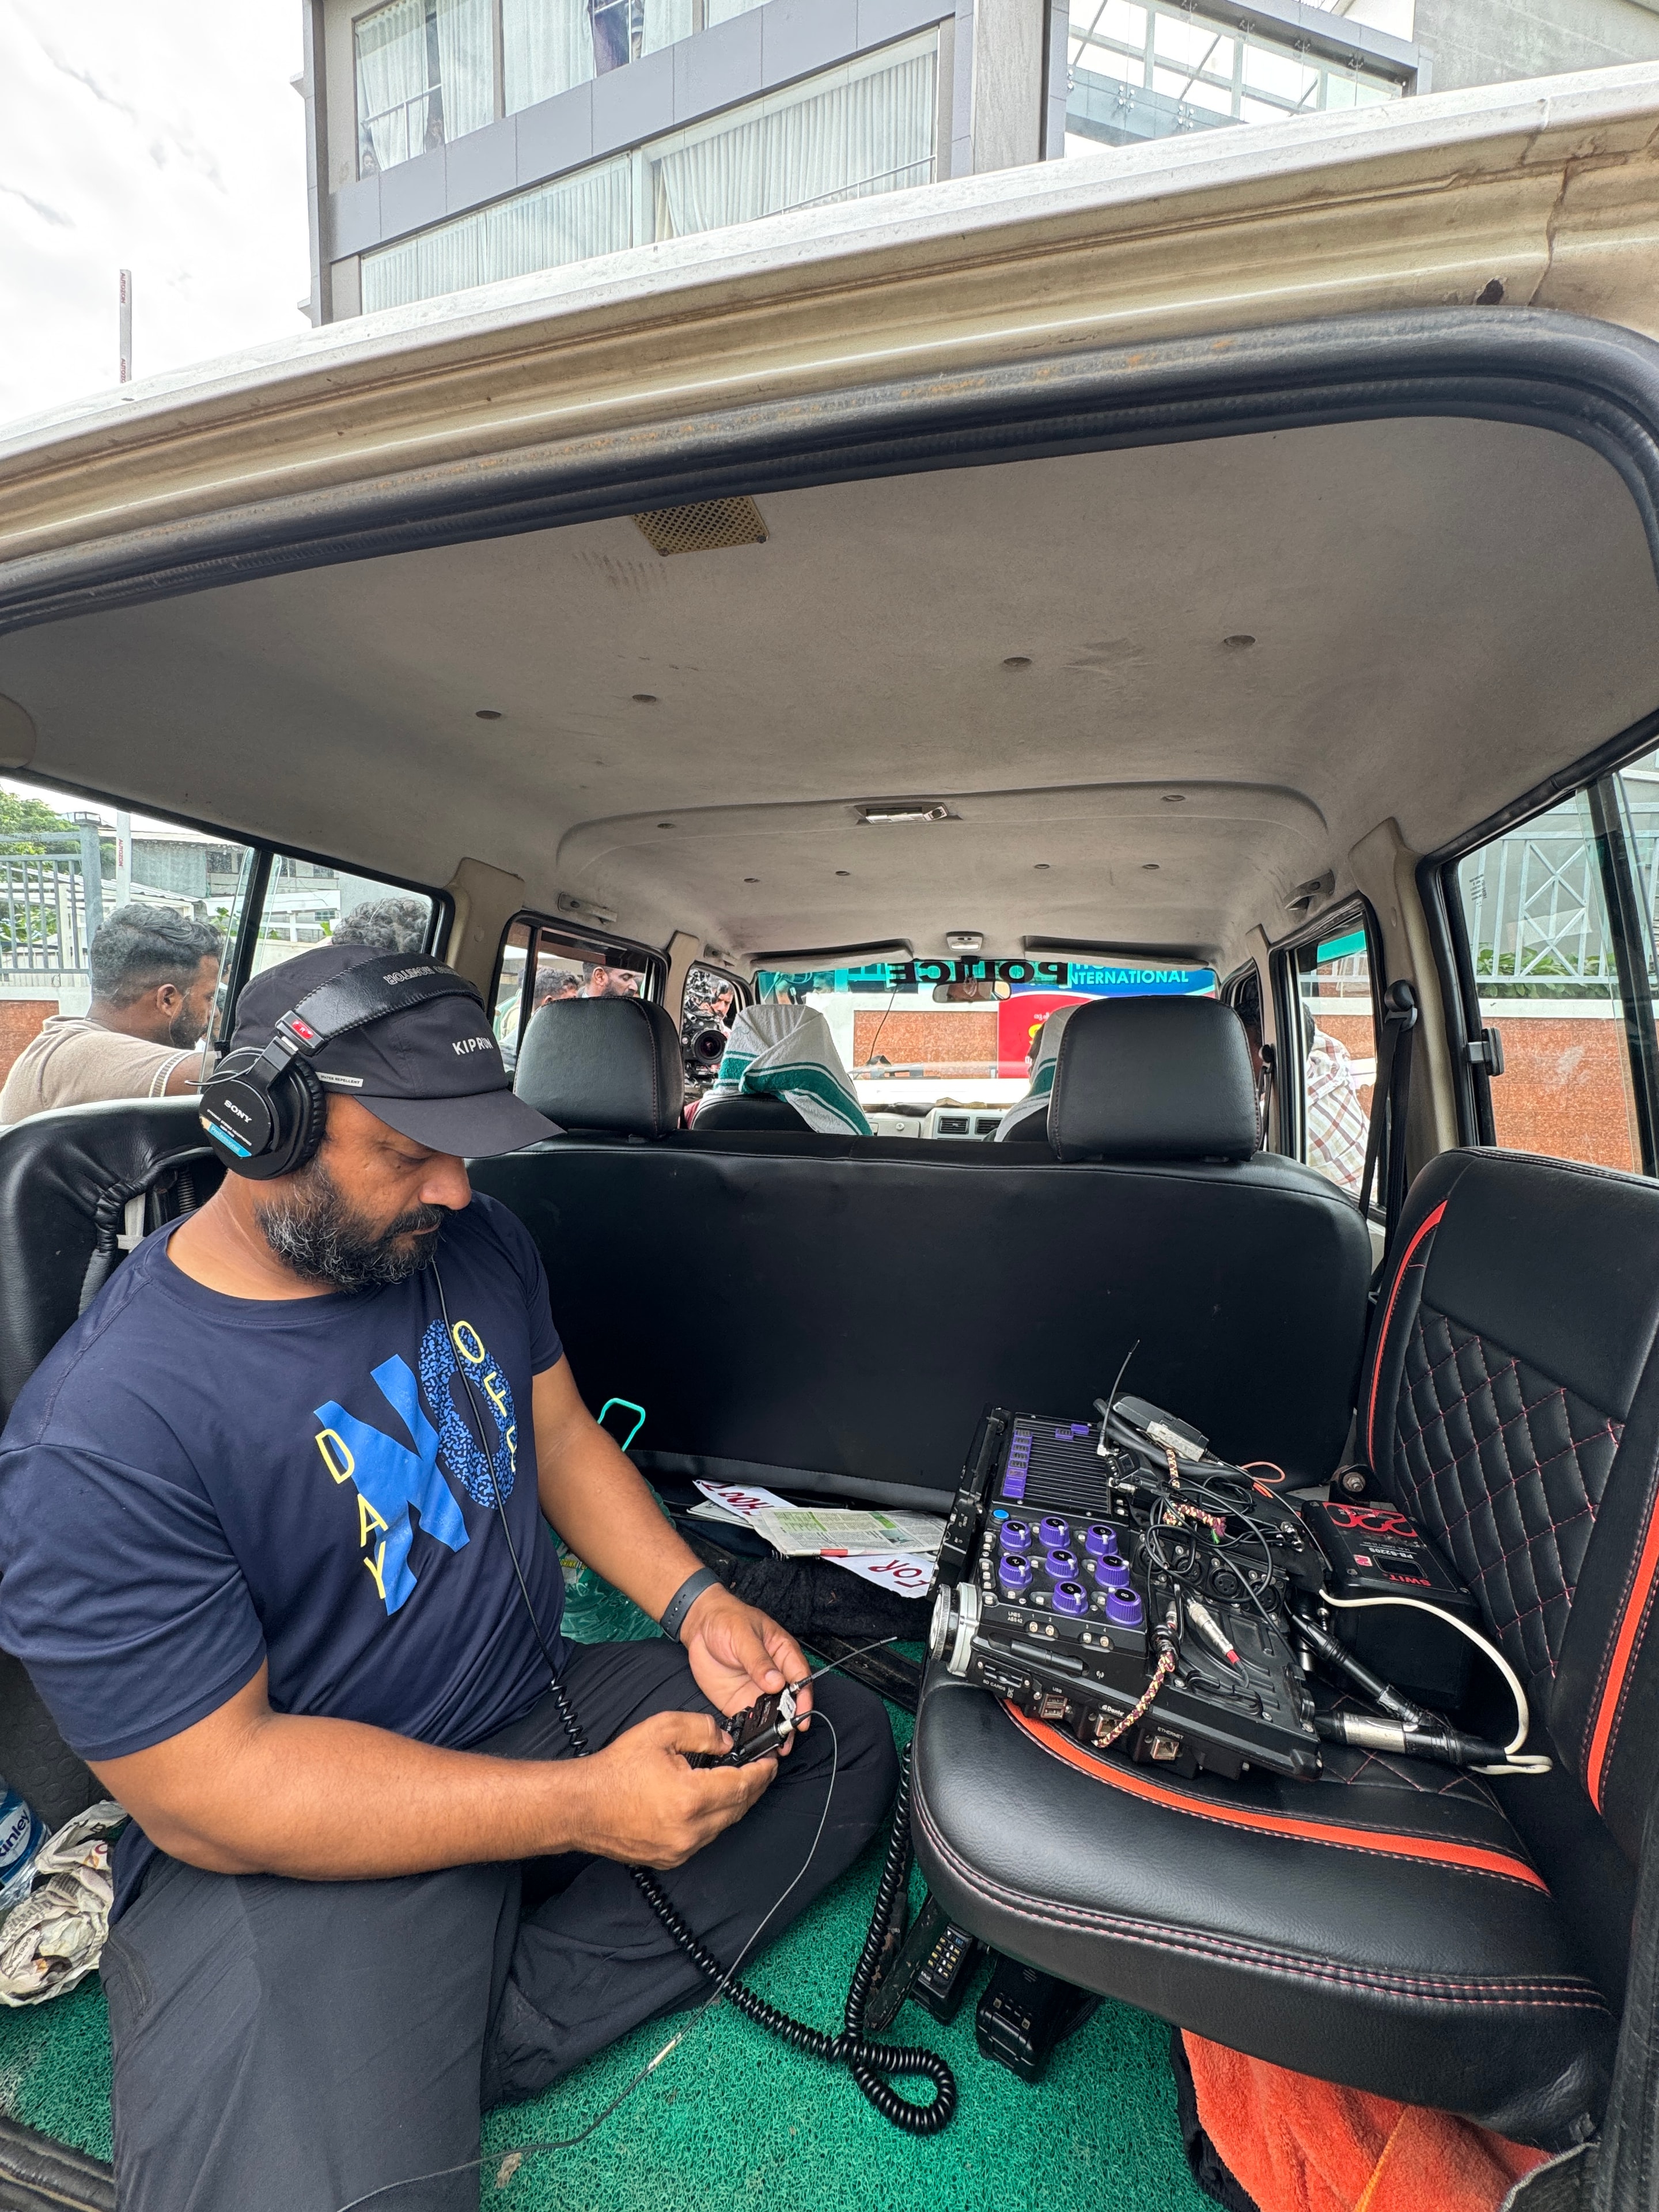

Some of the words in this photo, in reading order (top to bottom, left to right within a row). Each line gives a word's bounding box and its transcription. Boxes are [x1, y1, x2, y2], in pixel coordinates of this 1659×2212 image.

[1070, 969, 1189, 984] NTERNATIONAL
[224, 1099, 252, 1123] SONY
[1389, 1574, 1431, 1586] SWIT
[990, 1681, 1006, 1691] CARDS
[1107, 1706, 1123, 1717] Dante
[1157, 1726, 1184, 1740] ETHERNET
